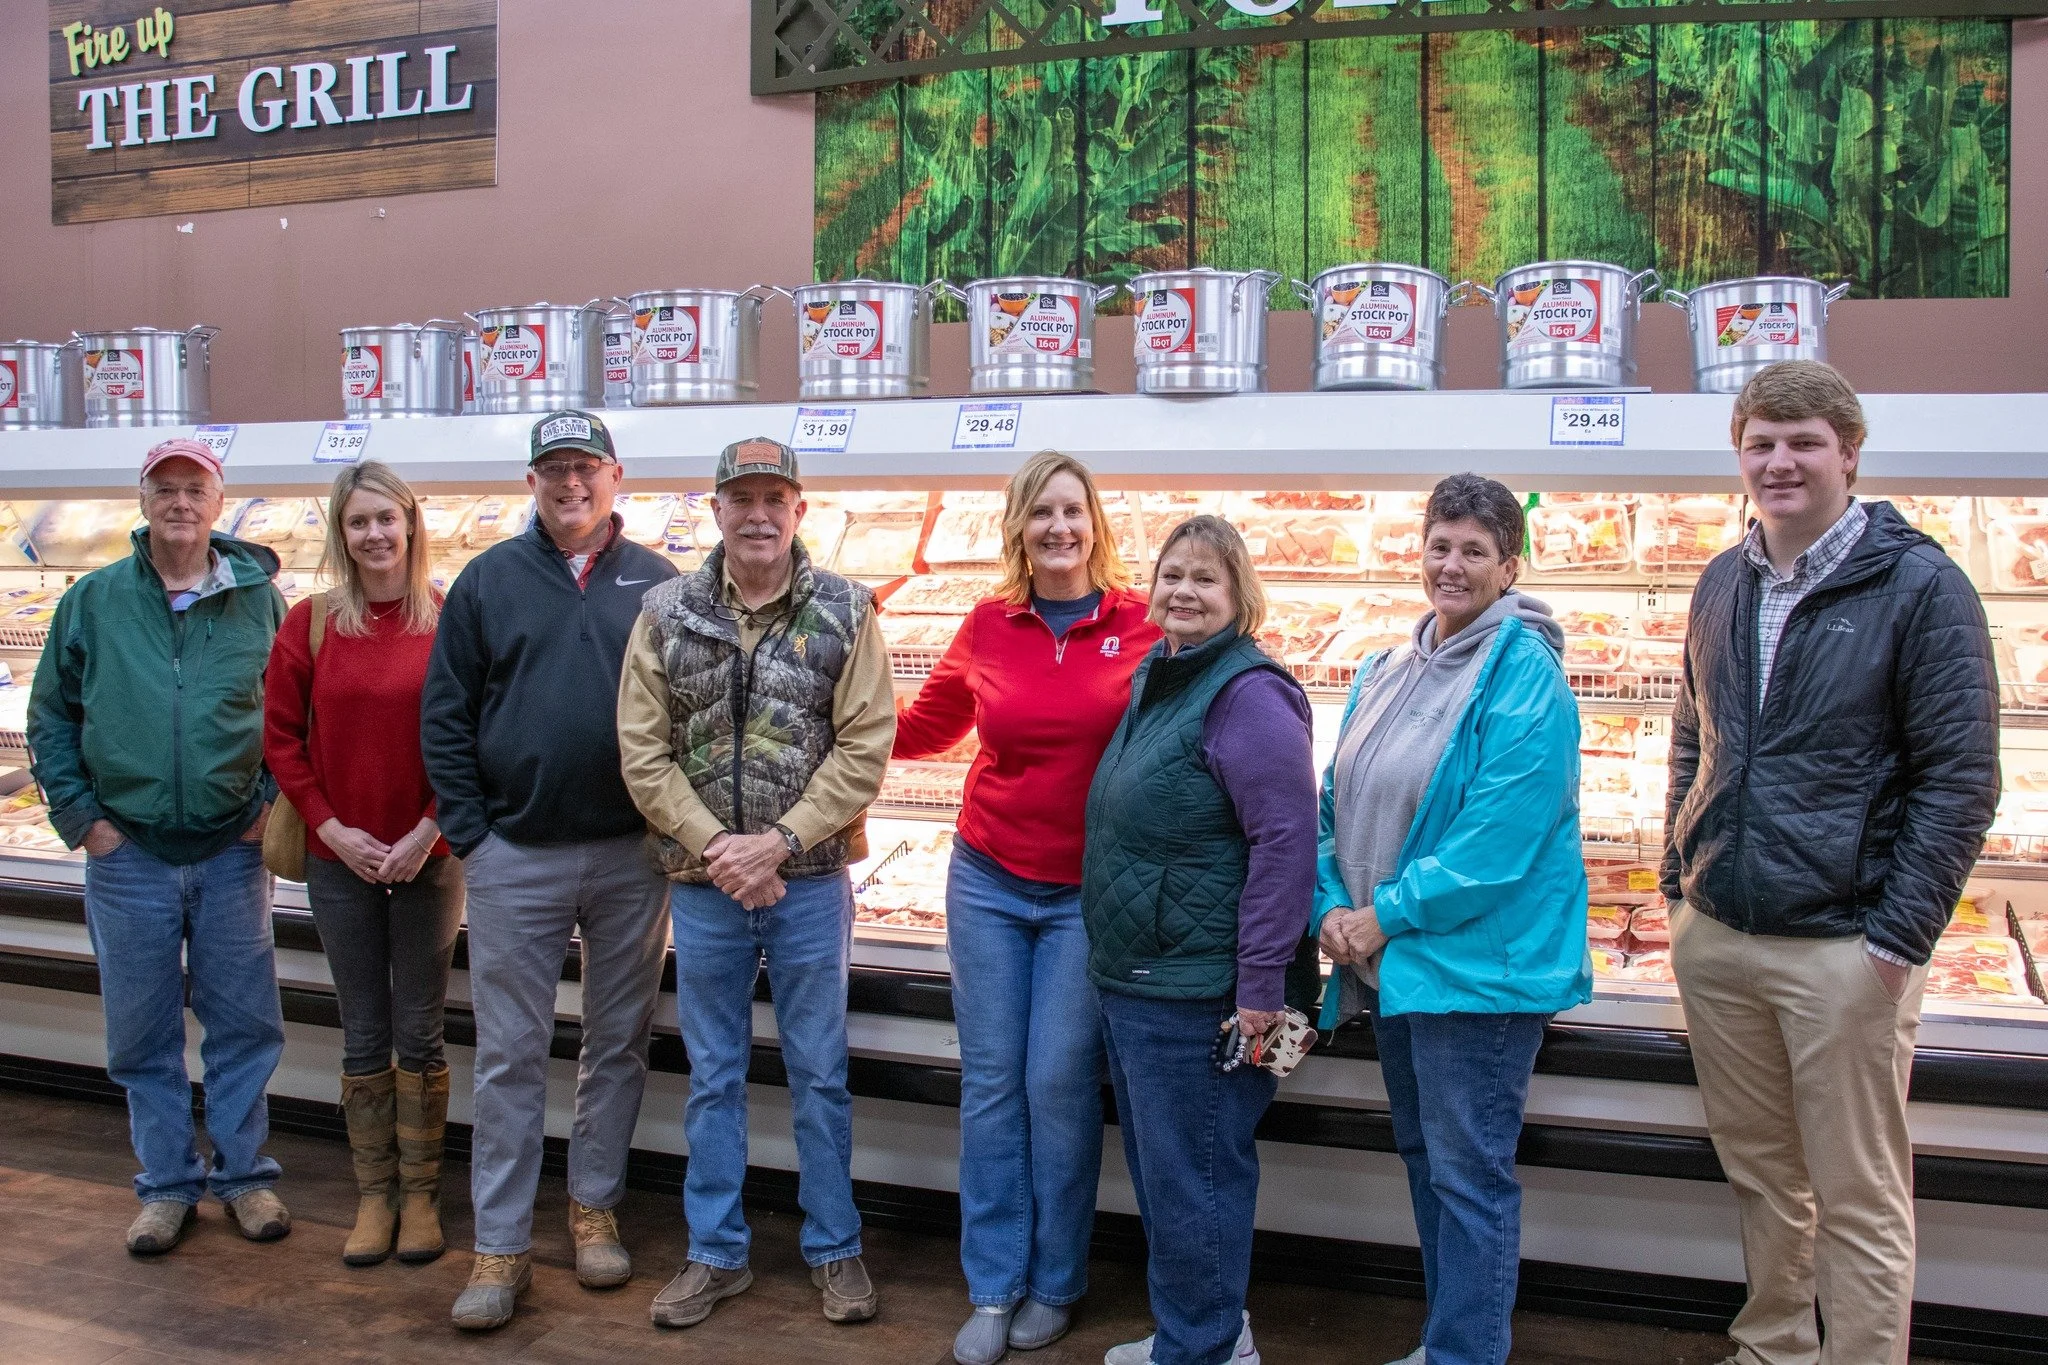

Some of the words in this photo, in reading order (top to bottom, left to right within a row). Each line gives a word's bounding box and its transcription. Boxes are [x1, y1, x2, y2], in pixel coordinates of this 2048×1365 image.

[62, 21, 130, 77] Fire
[136, 6, 175, 59] up
[78, 74, 218, 150] THE
[237, 45, 473, 133] GRILL
[1146, 312, 1177, 320] ALUMINUM
[1351, 311, 1385, 321] STOCK
[1388, 311, 1409, 322] POT
[1534, 309, 1568, 320] STOCK
[1571, 308, 1593, 319] POT
[1021, 322, 1054, 332] STOCK
[1056, 325, 1073, 333] POT
[1141, 320, 1165, 332] STOCK
[1167, 318, 1187, 329] POT
[646, 334, 672, 344] STOCK
[673, 333, 692, 342] POT
[823, 328, 854, 338] STOCK
[856, 328, 875, 337] POT
[493, 350, 519, 360] STOCK
[520, 349, 538, 359] POT
[97, 373, 119, 381] STOCK
[121, 372, 138, 380] POT
[344, 370, 360, 380] STOCK
[360, 369, 376, 378] POT
[966, 418, 1014, 432] $29.48
[1562, 412, 1620, 427] $29.48
[565, 423, 588, 435] SWINE
[803, 422, 848, 436] $31.99
[327, 435, 363, 448] $31.99
